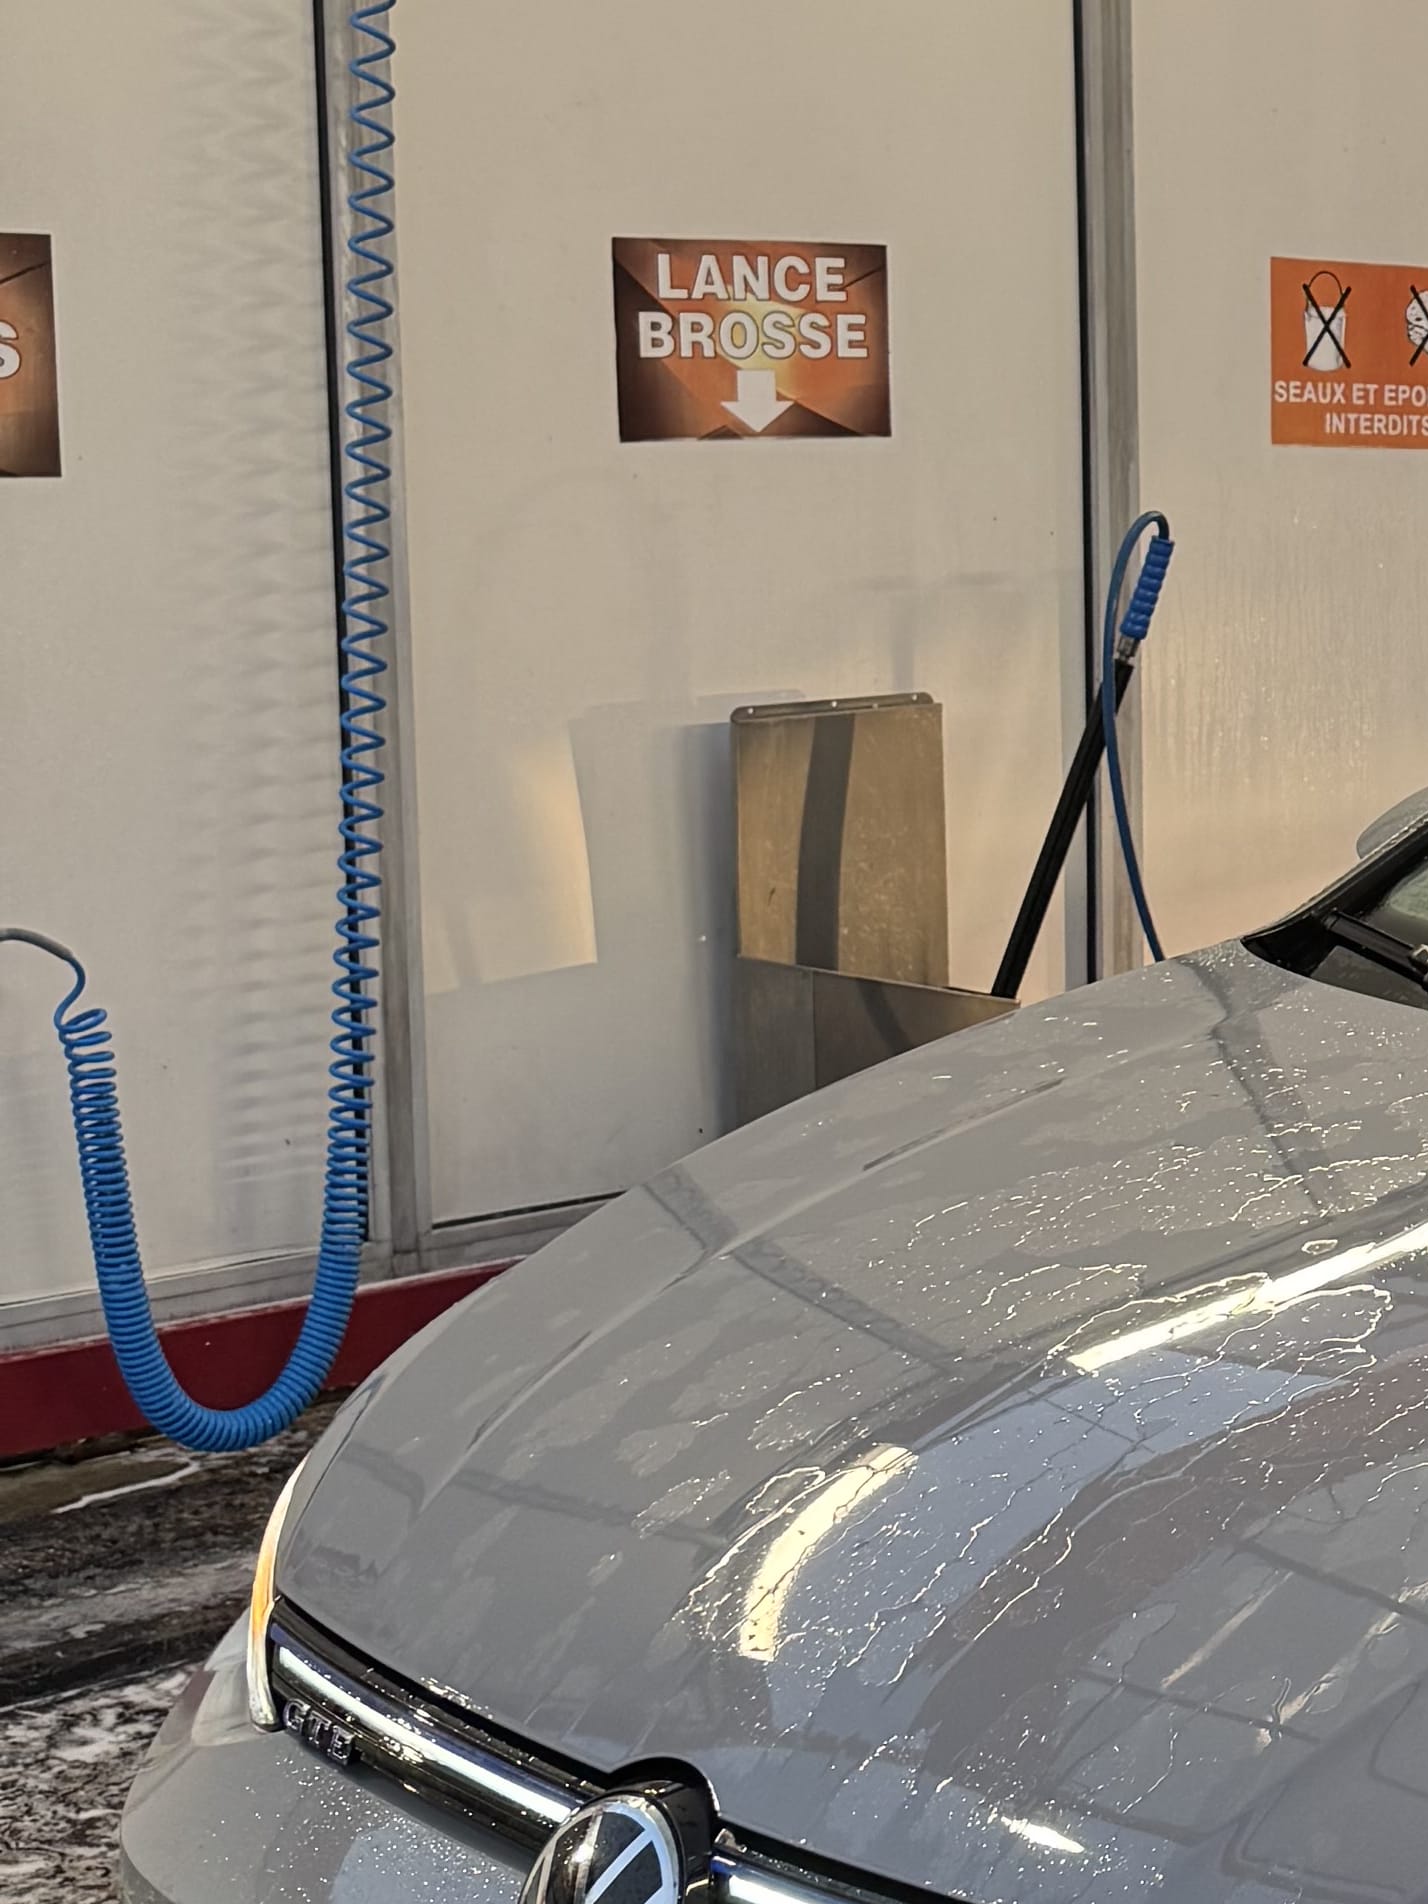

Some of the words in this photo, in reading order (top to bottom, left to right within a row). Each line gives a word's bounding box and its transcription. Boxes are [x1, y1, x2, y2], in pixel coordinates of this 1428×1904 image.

[657, 253, 848, 302] LANCE
[638, 310, 869, 359] BROSSE
[1274, 380, 1347, 404] SEAUX
[1352, 383, 1379, 405] ET
[282, 1698, 355, 1765] GTE
